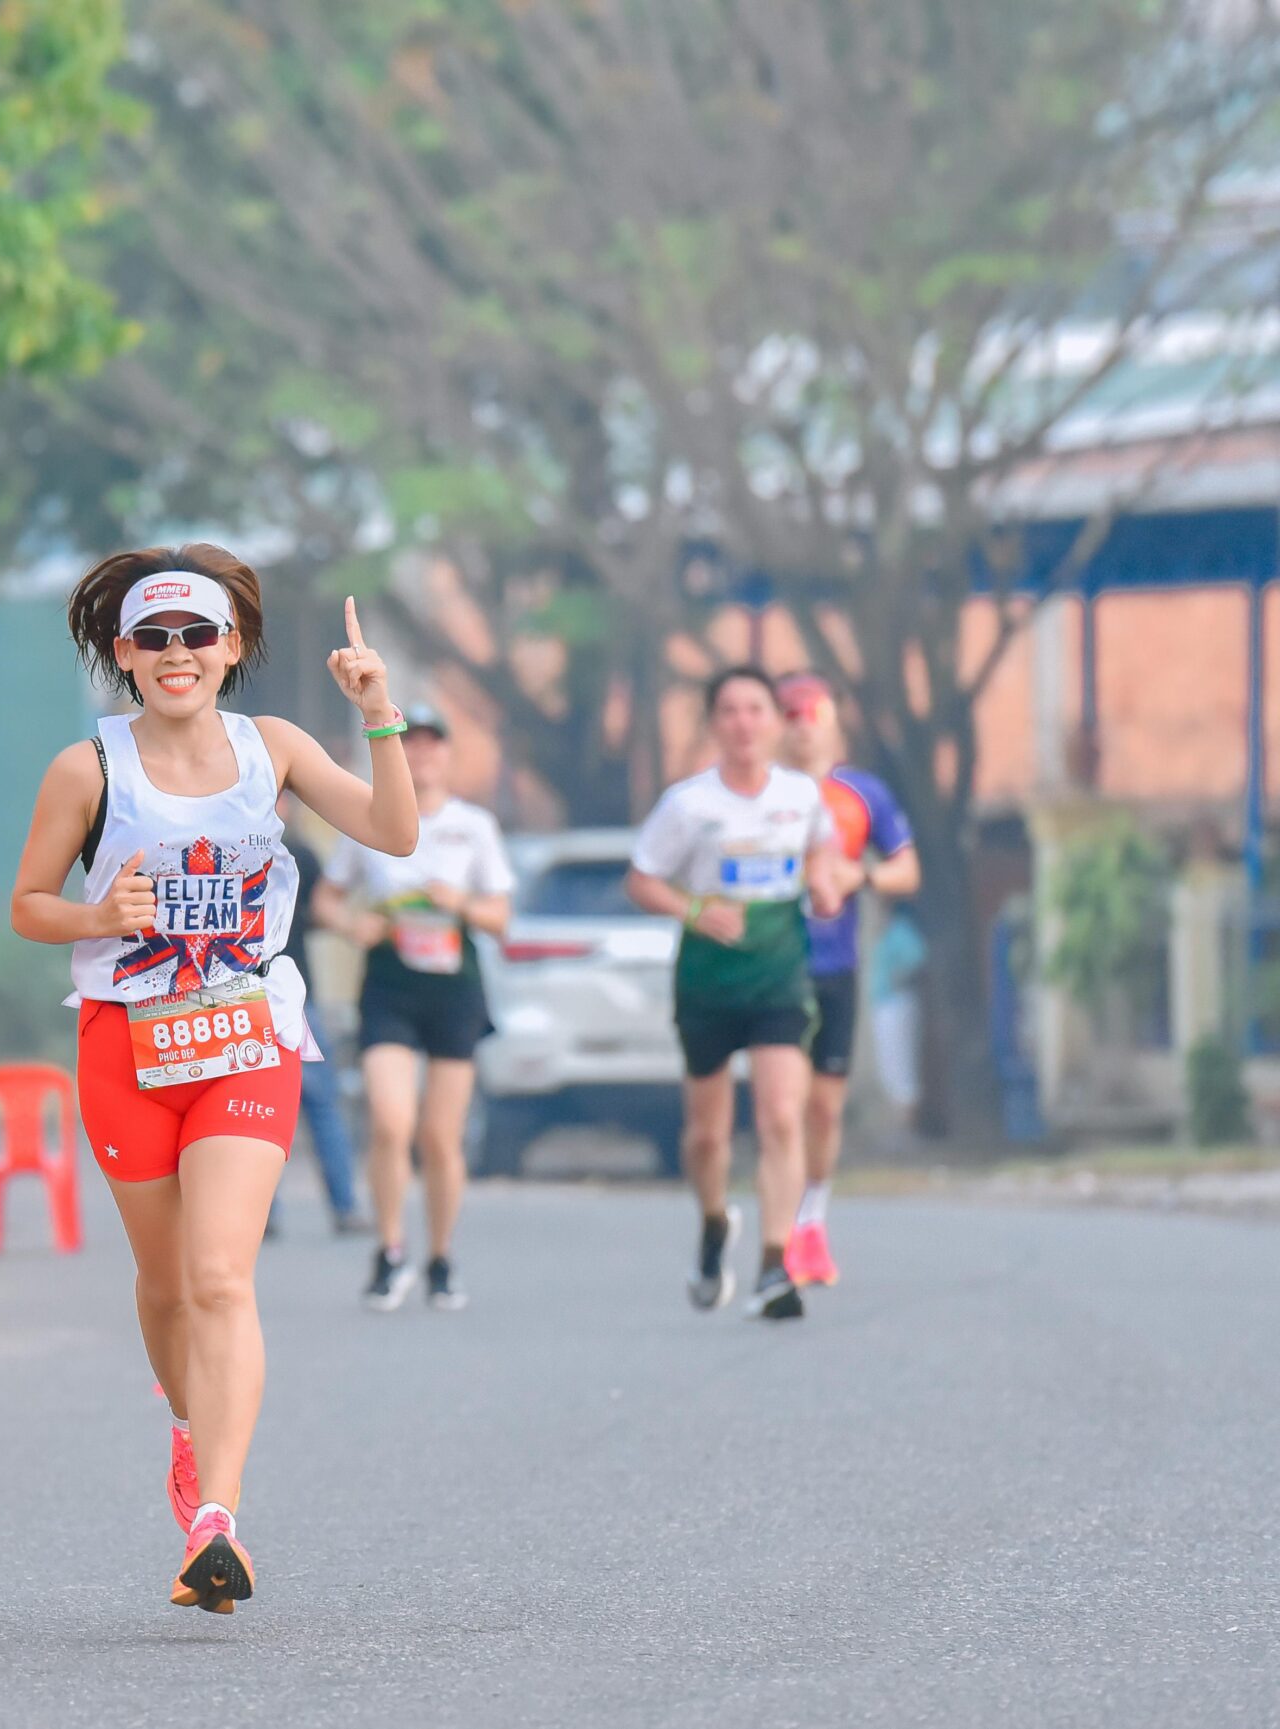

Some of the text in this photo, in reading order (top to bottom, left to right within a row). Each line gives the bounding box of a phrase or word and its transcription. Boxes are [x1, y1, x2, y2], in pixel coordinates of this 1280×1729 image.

[145, 585, 188, 596] HAMMER
[249, 834, 271, 847] Elite
[165, 878, 235, 901] ELITE
[164, 902, 238, 930] TEAM
[135, 996, 156, 1008] DUY
[153, 1009, 251, 1049] 88888
[263, 1026, 273, 1048] km
[158, 1048, 196, 1063] PHÚC ĐẸP
[223, 1038, 264, 1072] 10
[227, 1099, 275, 1117] Elite
